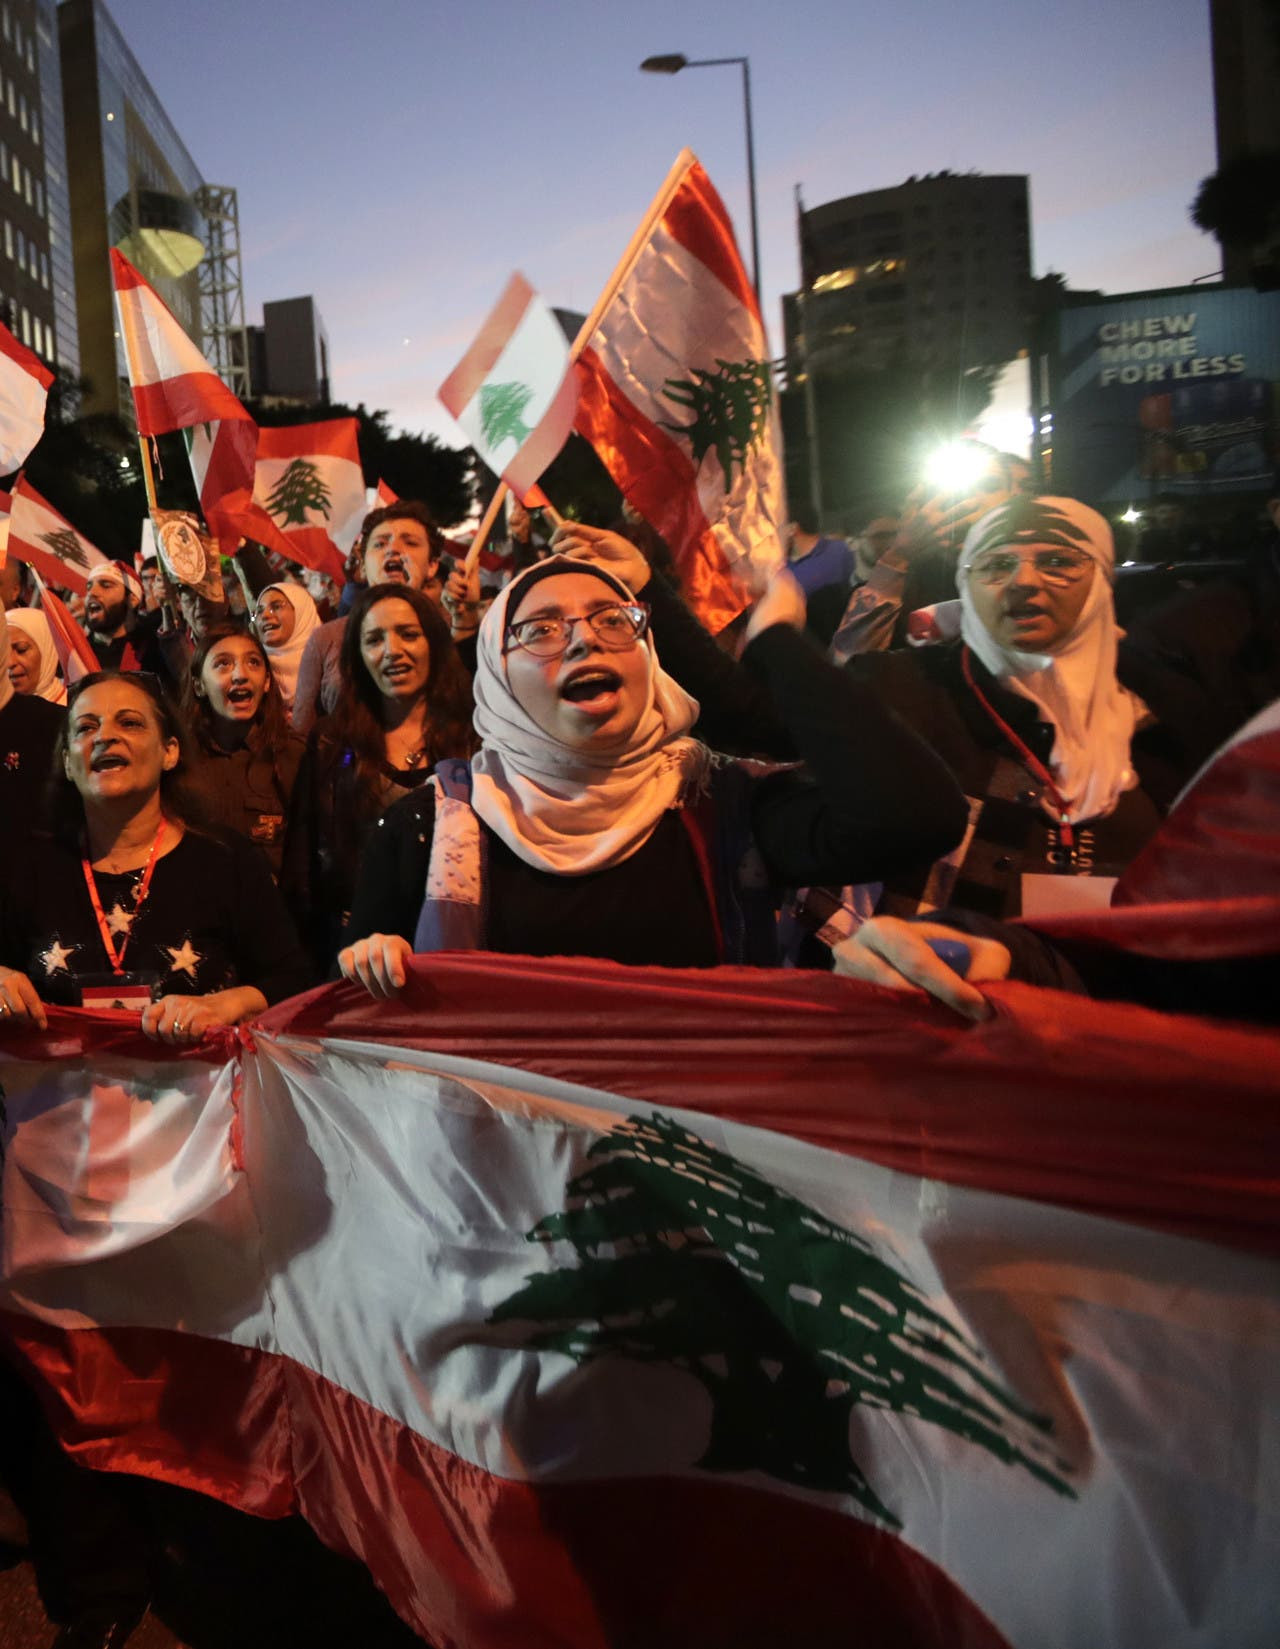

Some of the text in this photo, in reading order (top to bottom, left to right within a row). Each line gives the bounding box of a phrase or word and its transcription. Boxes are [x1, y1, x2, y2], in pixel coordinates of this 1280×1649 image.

[1099, 313, 1196, 342] CHEW
[1100, 336, 1197, 363] MORE
[1100, 353, 1246, 386] FOR LESS
